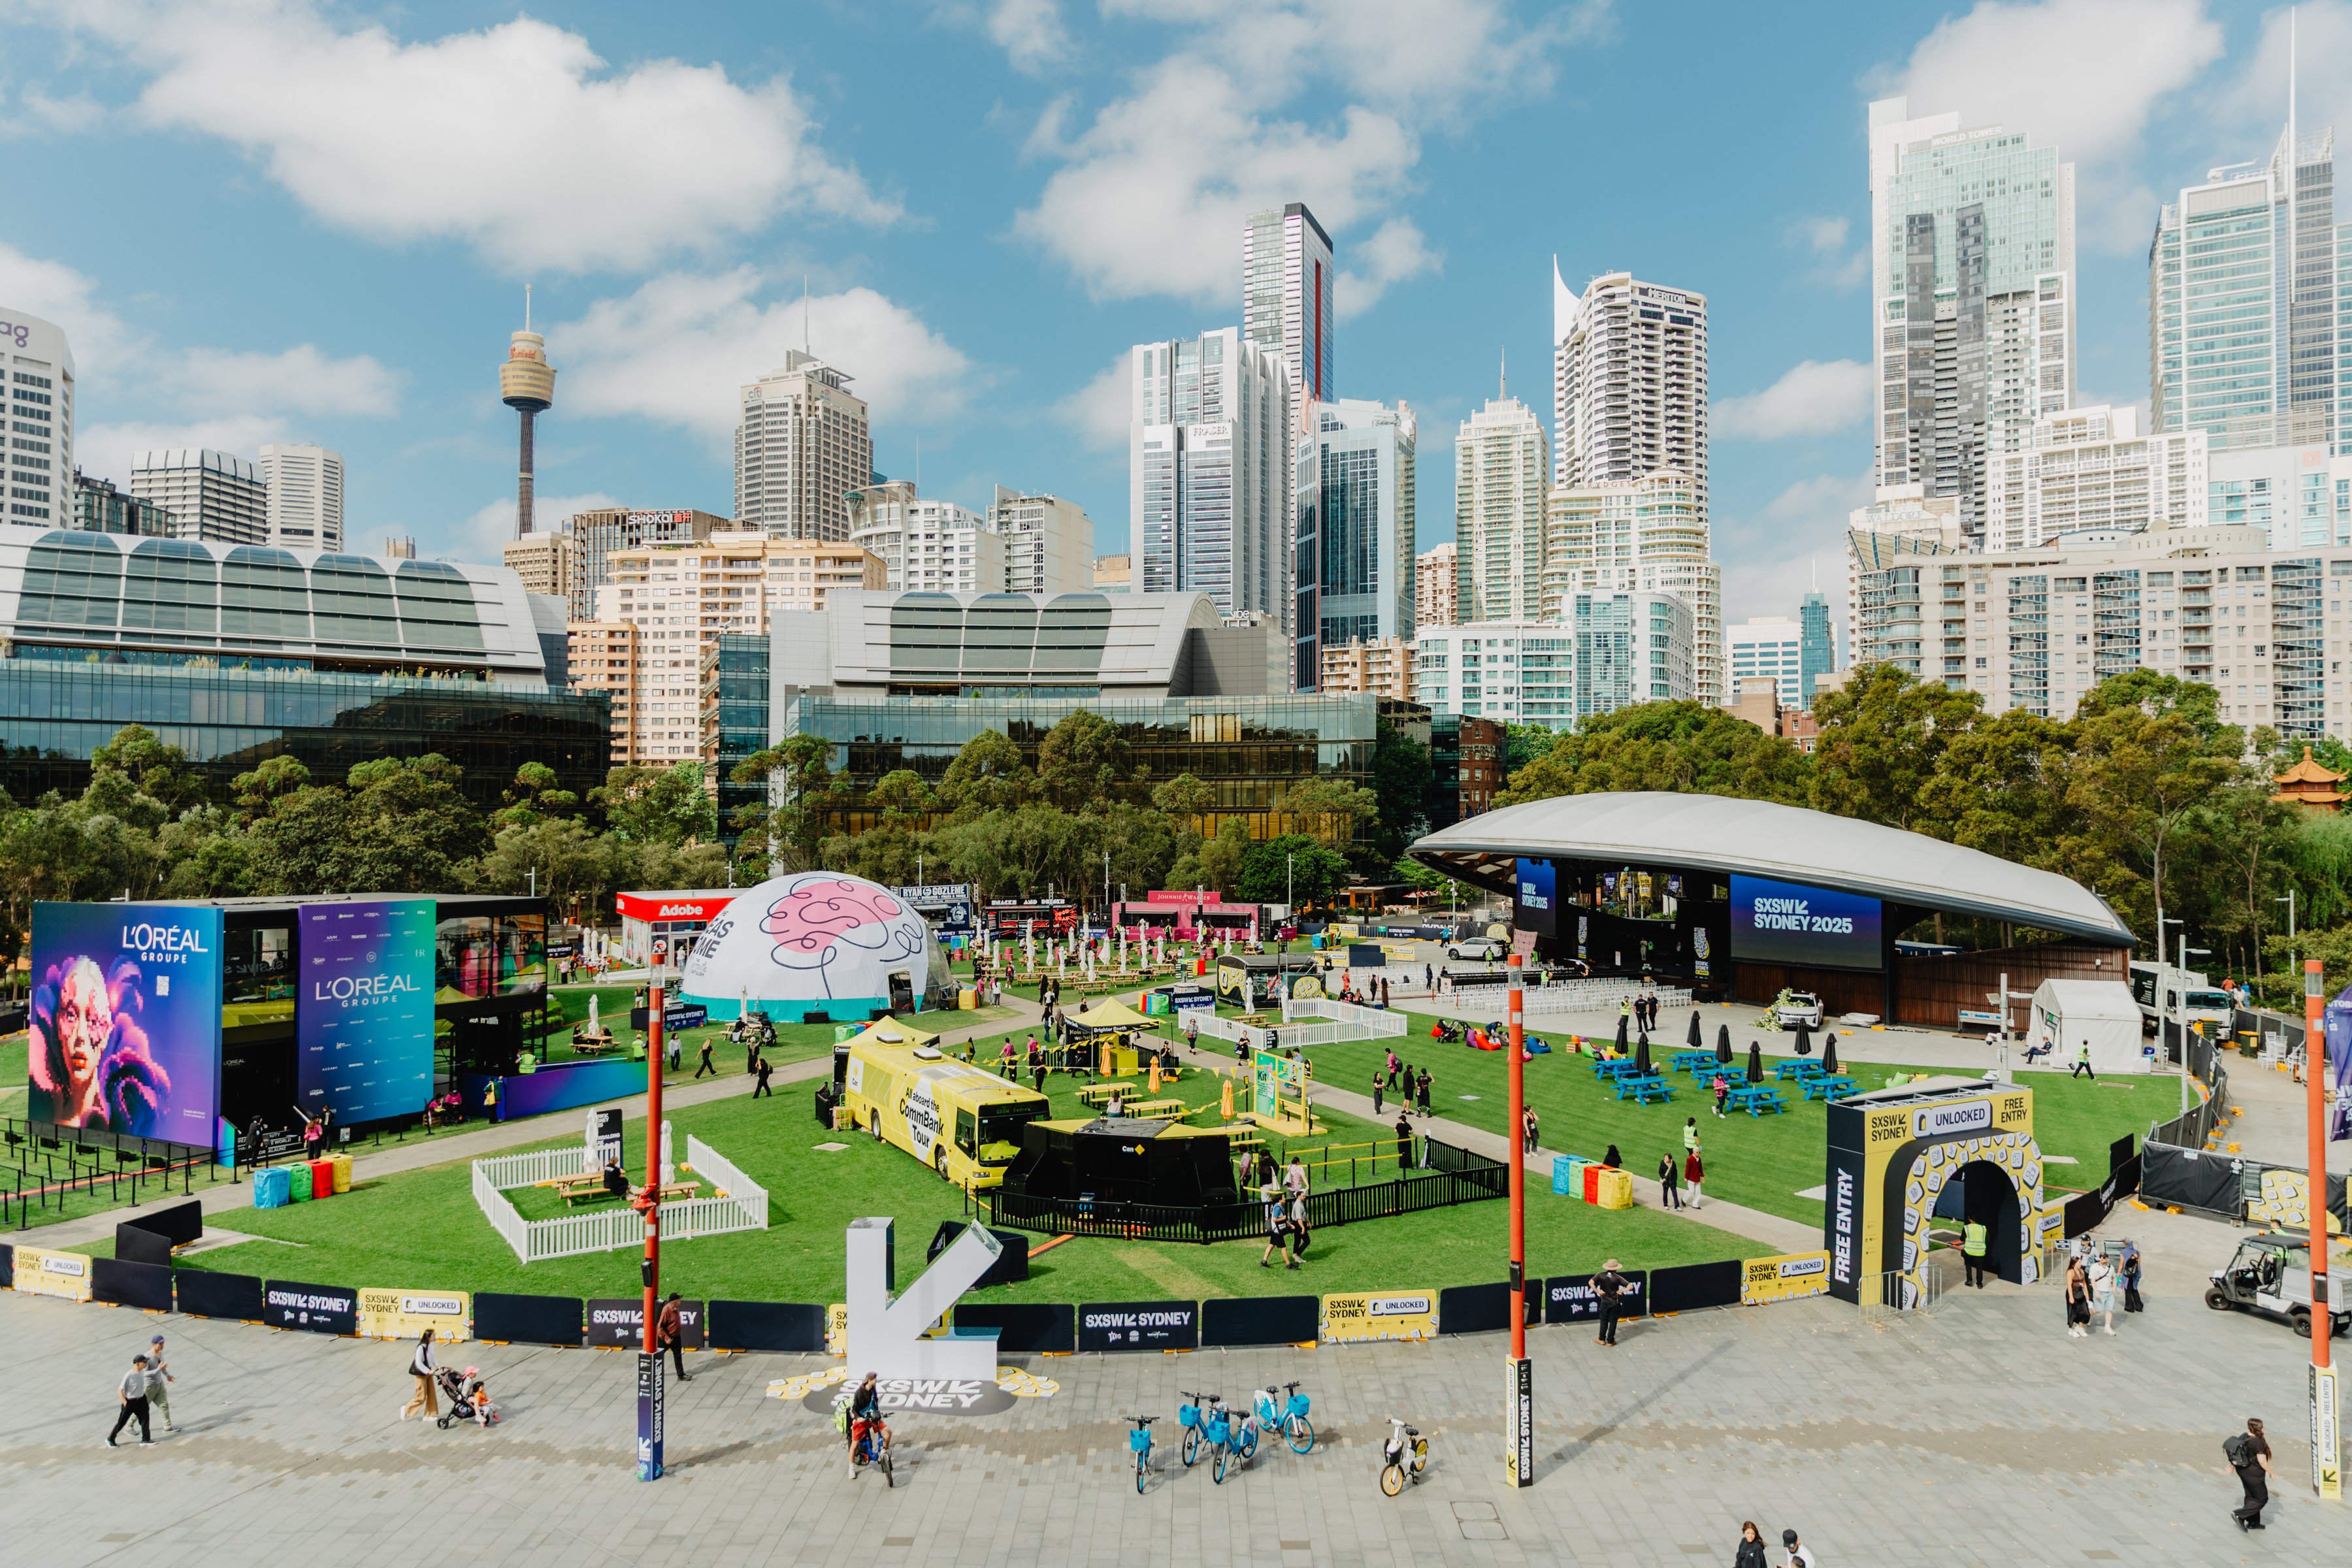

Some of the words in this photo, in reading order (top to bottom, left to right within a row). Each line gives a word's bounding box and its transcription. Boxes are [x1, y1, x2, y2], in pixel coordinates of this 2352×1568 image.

[1932, 134, 1966, 145] WORLD
[1968, 126, 2002, 139] TOWER
[1648, 288, 1686, 304] MERITON
[748, 386, 762, 399] citi
[1194, 427, 1228, 436] FRASER
[1866, 511, 1923, 523] WALDORF
[903, 888, 923, 897] RYAN
[932, 886, 965, 896] GOZLEME
[1522, 894, 1536, 907] SYDNEY
[1535, 896, 1548, 909] 2025
[1754, 898, 1794, 913] SXSW
[659, 904, 703, 917] Adobe
[1754, 913, 1810, 930] SYDNEY
[1812, 916, 1853, 934] 2025
[122, 923, 208, 953] L'ORÉAL
[141, 951, 187, 964] GROUPE
[315, 973, 421, 1000] L'ORÉAL
[342, 995, 397, 1007] GROUPE
[1258, 1070, 1267, 1081] Kit
[913, 1092, 930, 1109] aboard
[2004, 1098, 2024, 1110] FREE
[900, 1098, 944, 1136] CommBank
[1872, 1114, 1897, 1128] SXSW
[1935, 1108, 1985, 1126] UNLOCKED
[2001, 1109, 2027, 1123] ENTRY
[912, 1124, 930, 1148] Tour
[1872, 1126, 1907, 1141] SYDNEY
[1837, 1167, 1853, 1234] ENTRY
[18, 1252, 35, 1261] SXSW
[1835, 1233, 1851, 1284] FREE
[18, 1261, 41, 1271] SYDNEY
[54, 1261, 80, 1271] UNLOCKED
[1749, 1264, 1770, 1273] SXSW
[1792, 1261, 1821, 1271] UNLOCKED
[1749, 1271, 1777, 1282] SYDNEY
[365, 1295, 389, 1303] SXSW
[1551, 1286, 1584, 1301] SXSW
[269, 1290, 298, 1307] SXSW
[308, 1296, 351, 1313] SYDNEY
[365, 1304, 399, 1313] SYDNEY
[418, 1301, 456, 1309] UNLOCKED
[1330, 1299, 1356, 1309] SXSW
[1386, 1301, 1424, 1309] UNLOCKED
[593, 1309, 630, 1324] SXSW
[1085, 1313, 1123, 1328] SXSW
[1138, 1311, 1191, 1327] SYDNEY
[1330, 1309, 1366, 1318] SYDNEY
[830, 1393, 984, 1408] SDNEY
[1520, 1394, 1530, 1437] SYDNEY
[1520, 1449, 1530, 1480] SXSW
